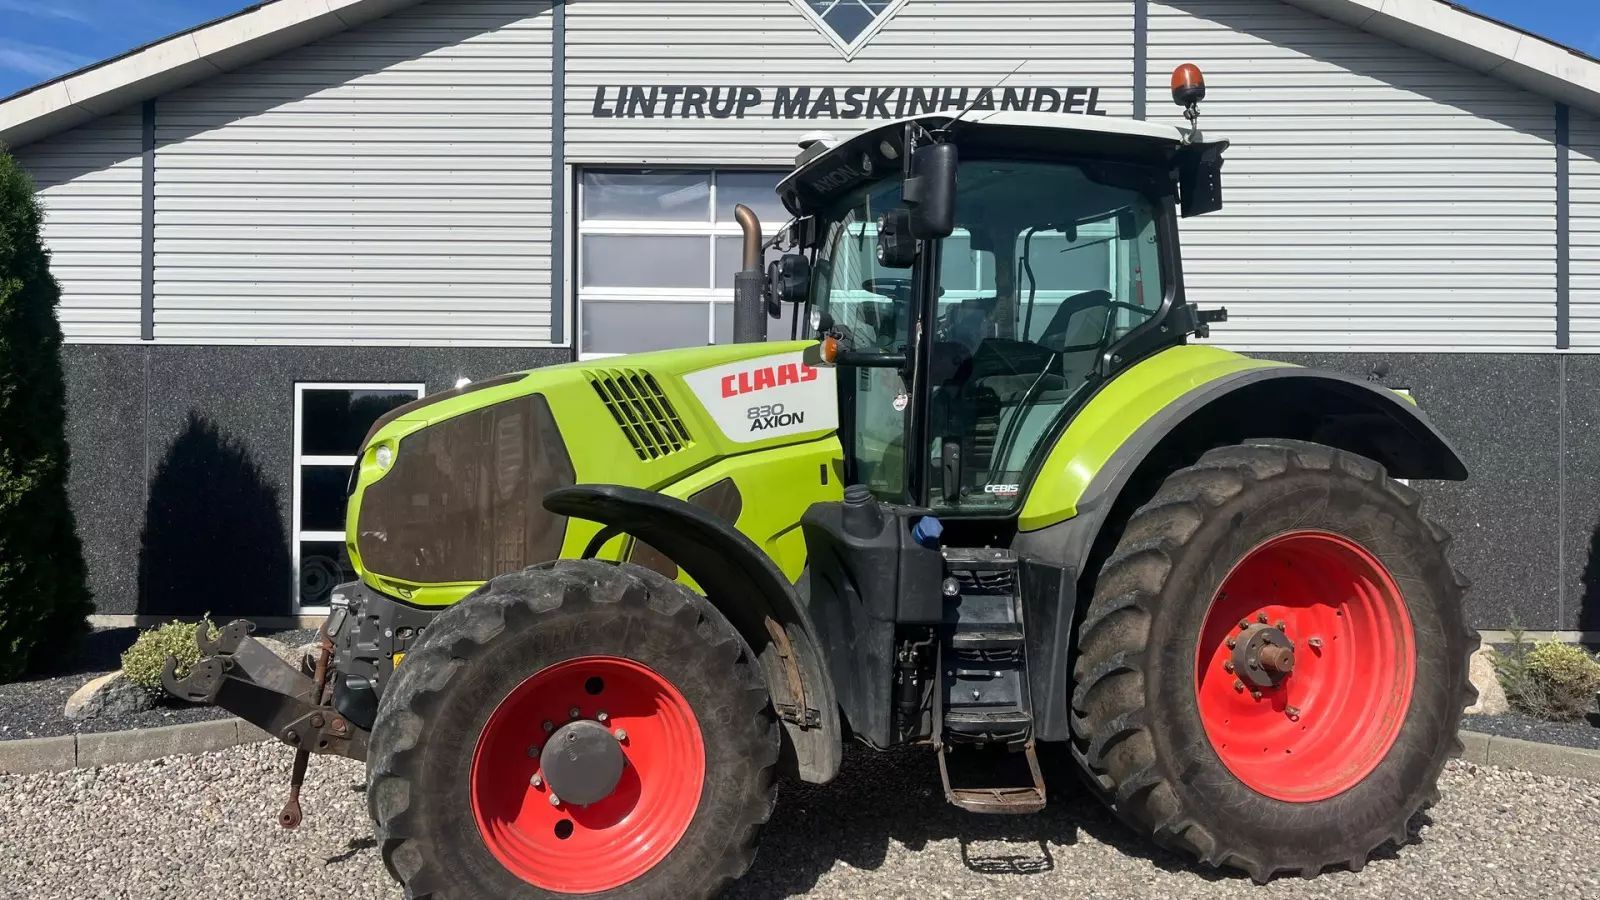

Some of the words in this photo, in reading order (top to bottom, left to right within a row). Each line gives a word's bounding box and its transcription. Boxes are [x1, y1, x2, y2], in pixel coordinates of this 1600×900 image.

[592, 86, 762, 118] LINTRUP
[772, 86, 1107, 119] MASKINHANDEL
[721, 362, 818, 399] CLAAS
[747, 403, 785, 420] 830
[750, 411, 804, 432] AXION
[984, 484, 1019, 493] CEBIS
